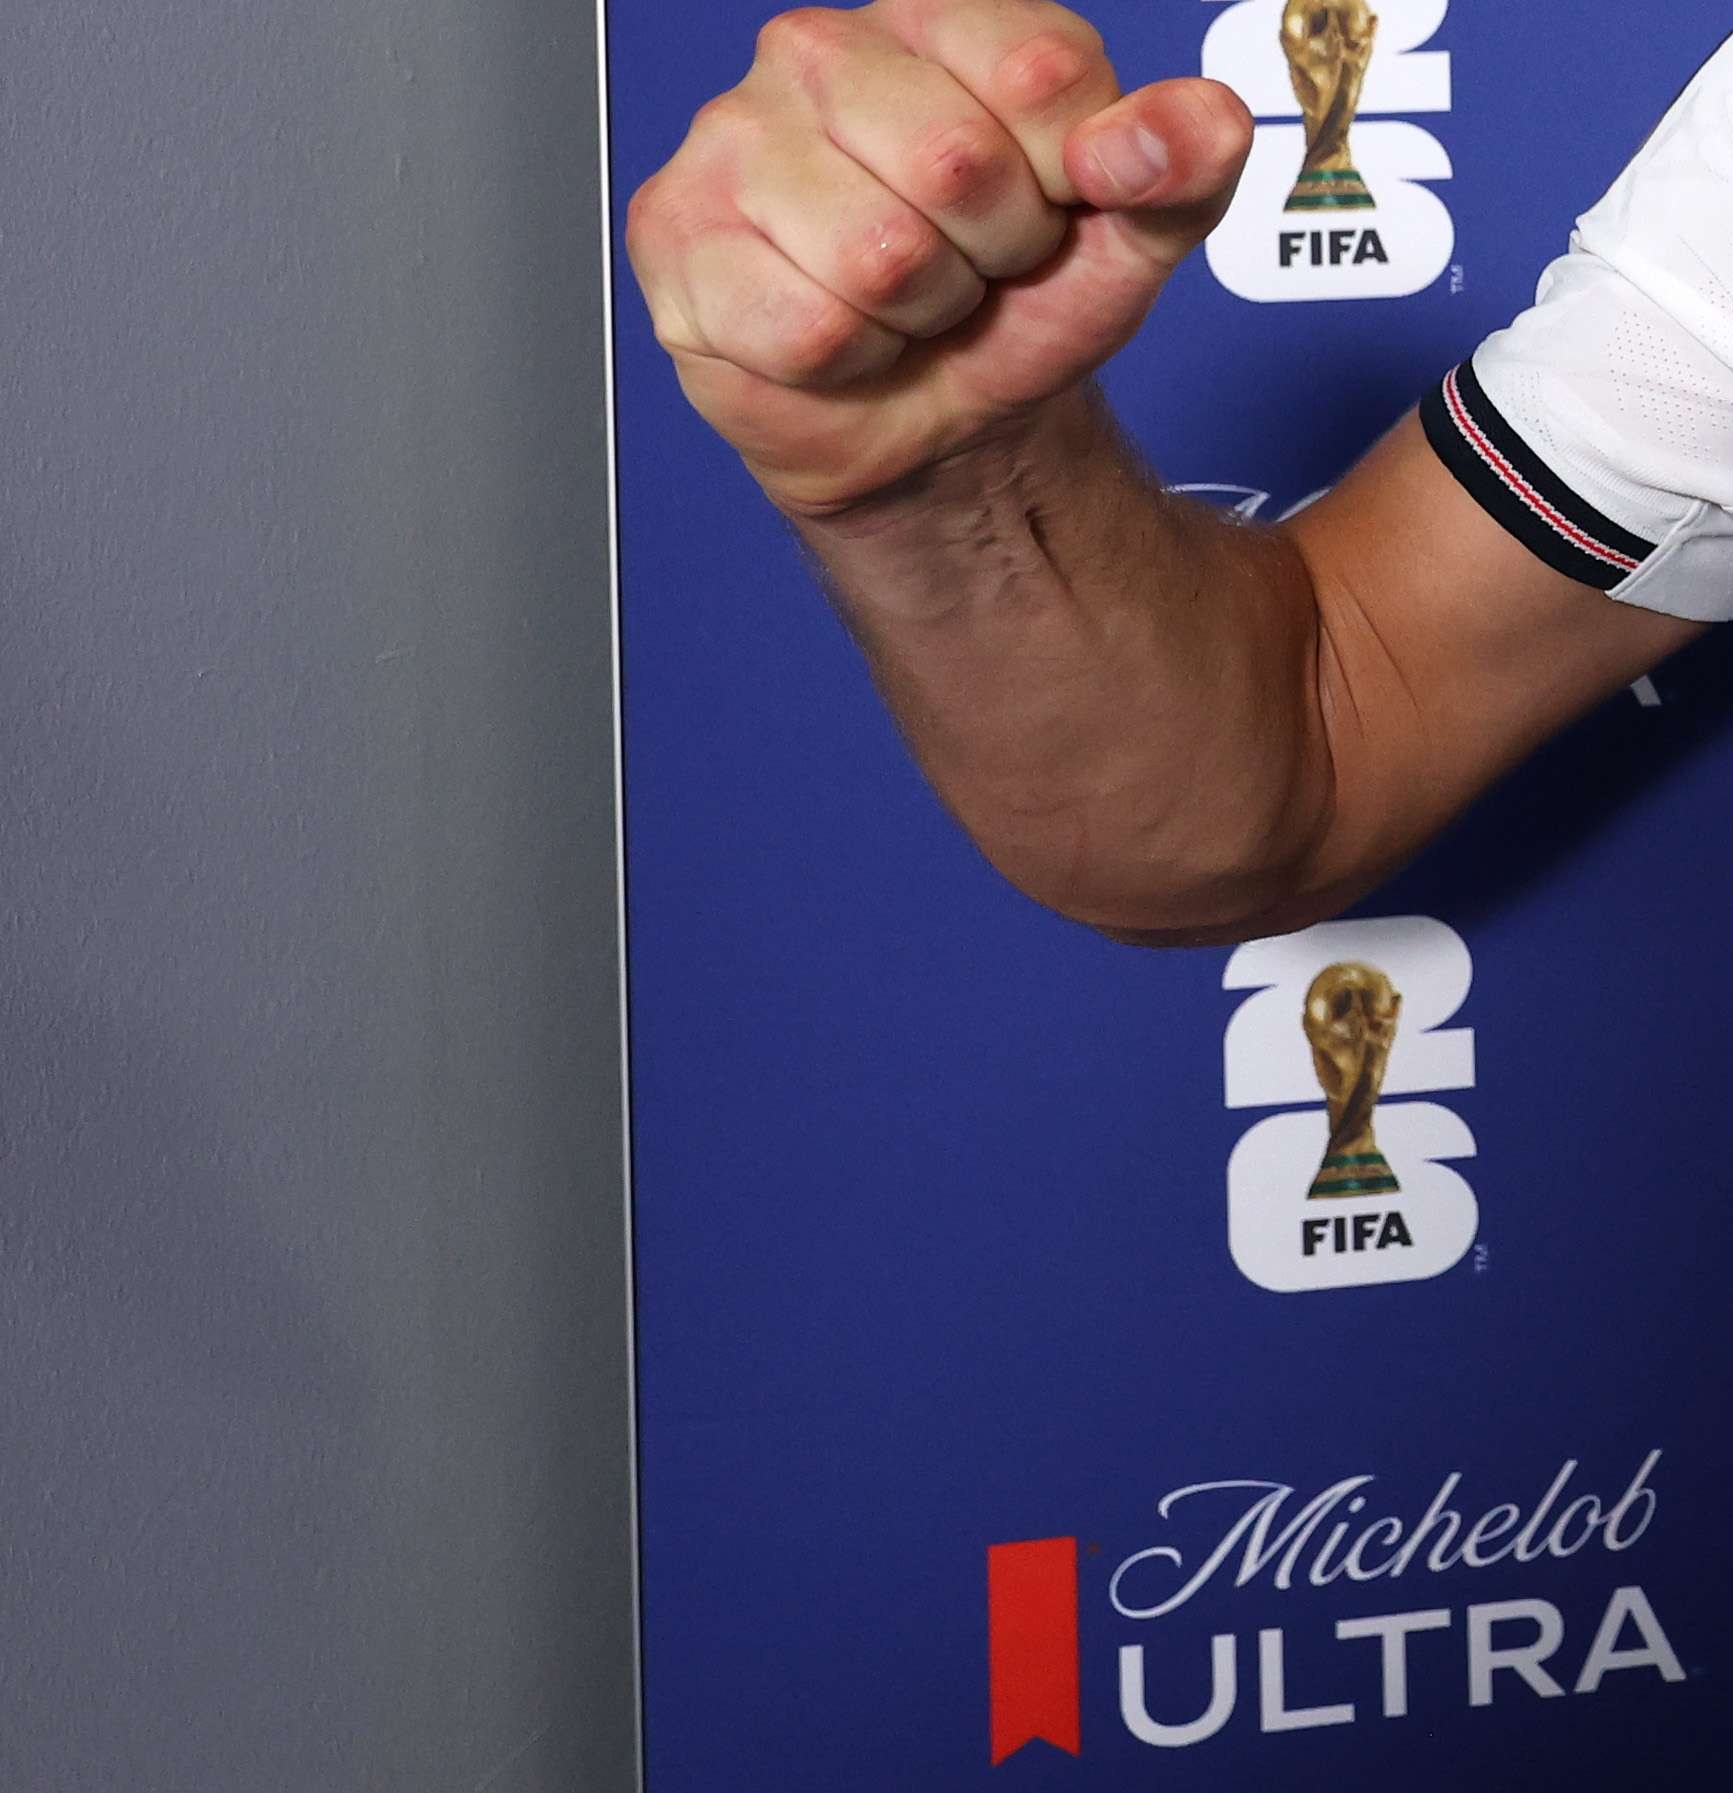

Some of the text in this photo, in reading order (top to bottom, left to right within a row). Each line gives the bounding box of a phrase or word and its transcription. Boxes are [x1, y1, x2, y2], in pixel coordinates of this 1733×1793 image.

[1279, 229, 1388, 267] FIFA
[1302, 1211, 1413, 1256] FIFA
[1110, 1449, 1661, 1620] Michelob
[1120, 1585, 1685, 1747] ULTRA
